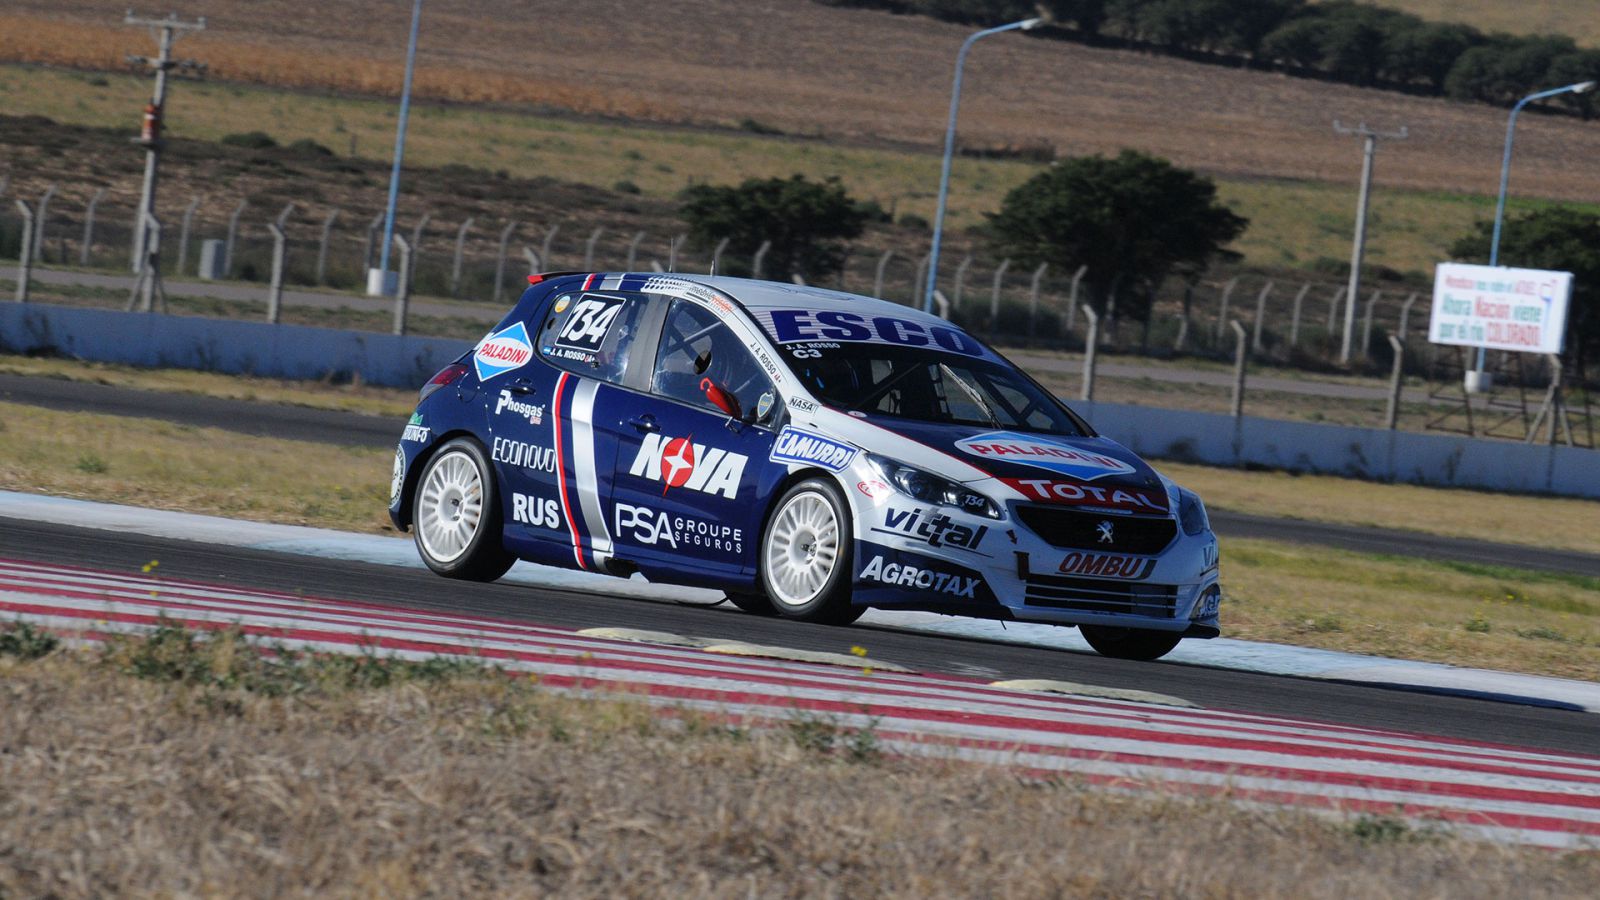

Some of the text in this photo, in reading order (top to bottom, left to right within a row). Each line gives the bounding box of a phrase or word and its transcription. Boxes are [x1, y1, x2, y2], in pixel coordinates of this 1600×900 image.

[560, 299, 622, 344] 134
[770, 309, 984, 357] ESCO
[479, 343, 529, 364] PALADINI
[563, 350, 586, 361] ROSSO
[760, 353, 777, 375] ROSSO
[792, 348, 823, 359] C3
[495, 389, 543, 418] Phosgas
[789, 397, 813, 412] NASA
[776, 431, 854, 468] CAMURRI
[969, 443, 1124, 469] PALADINI
[629, 432, 749, 500] NOVA
[964, 494, 985, 508] 134
[1019, 479, 1169, 512] TOTAL
[513, 492, 561, 529] RUS
[615, 502, 742, 549] PSA GROUPE
[674, 531, 742, 554] SEGUROS
[859, 555, 981, 599] AGROTAX
[1058, 552, 1143, 578] OMBU
